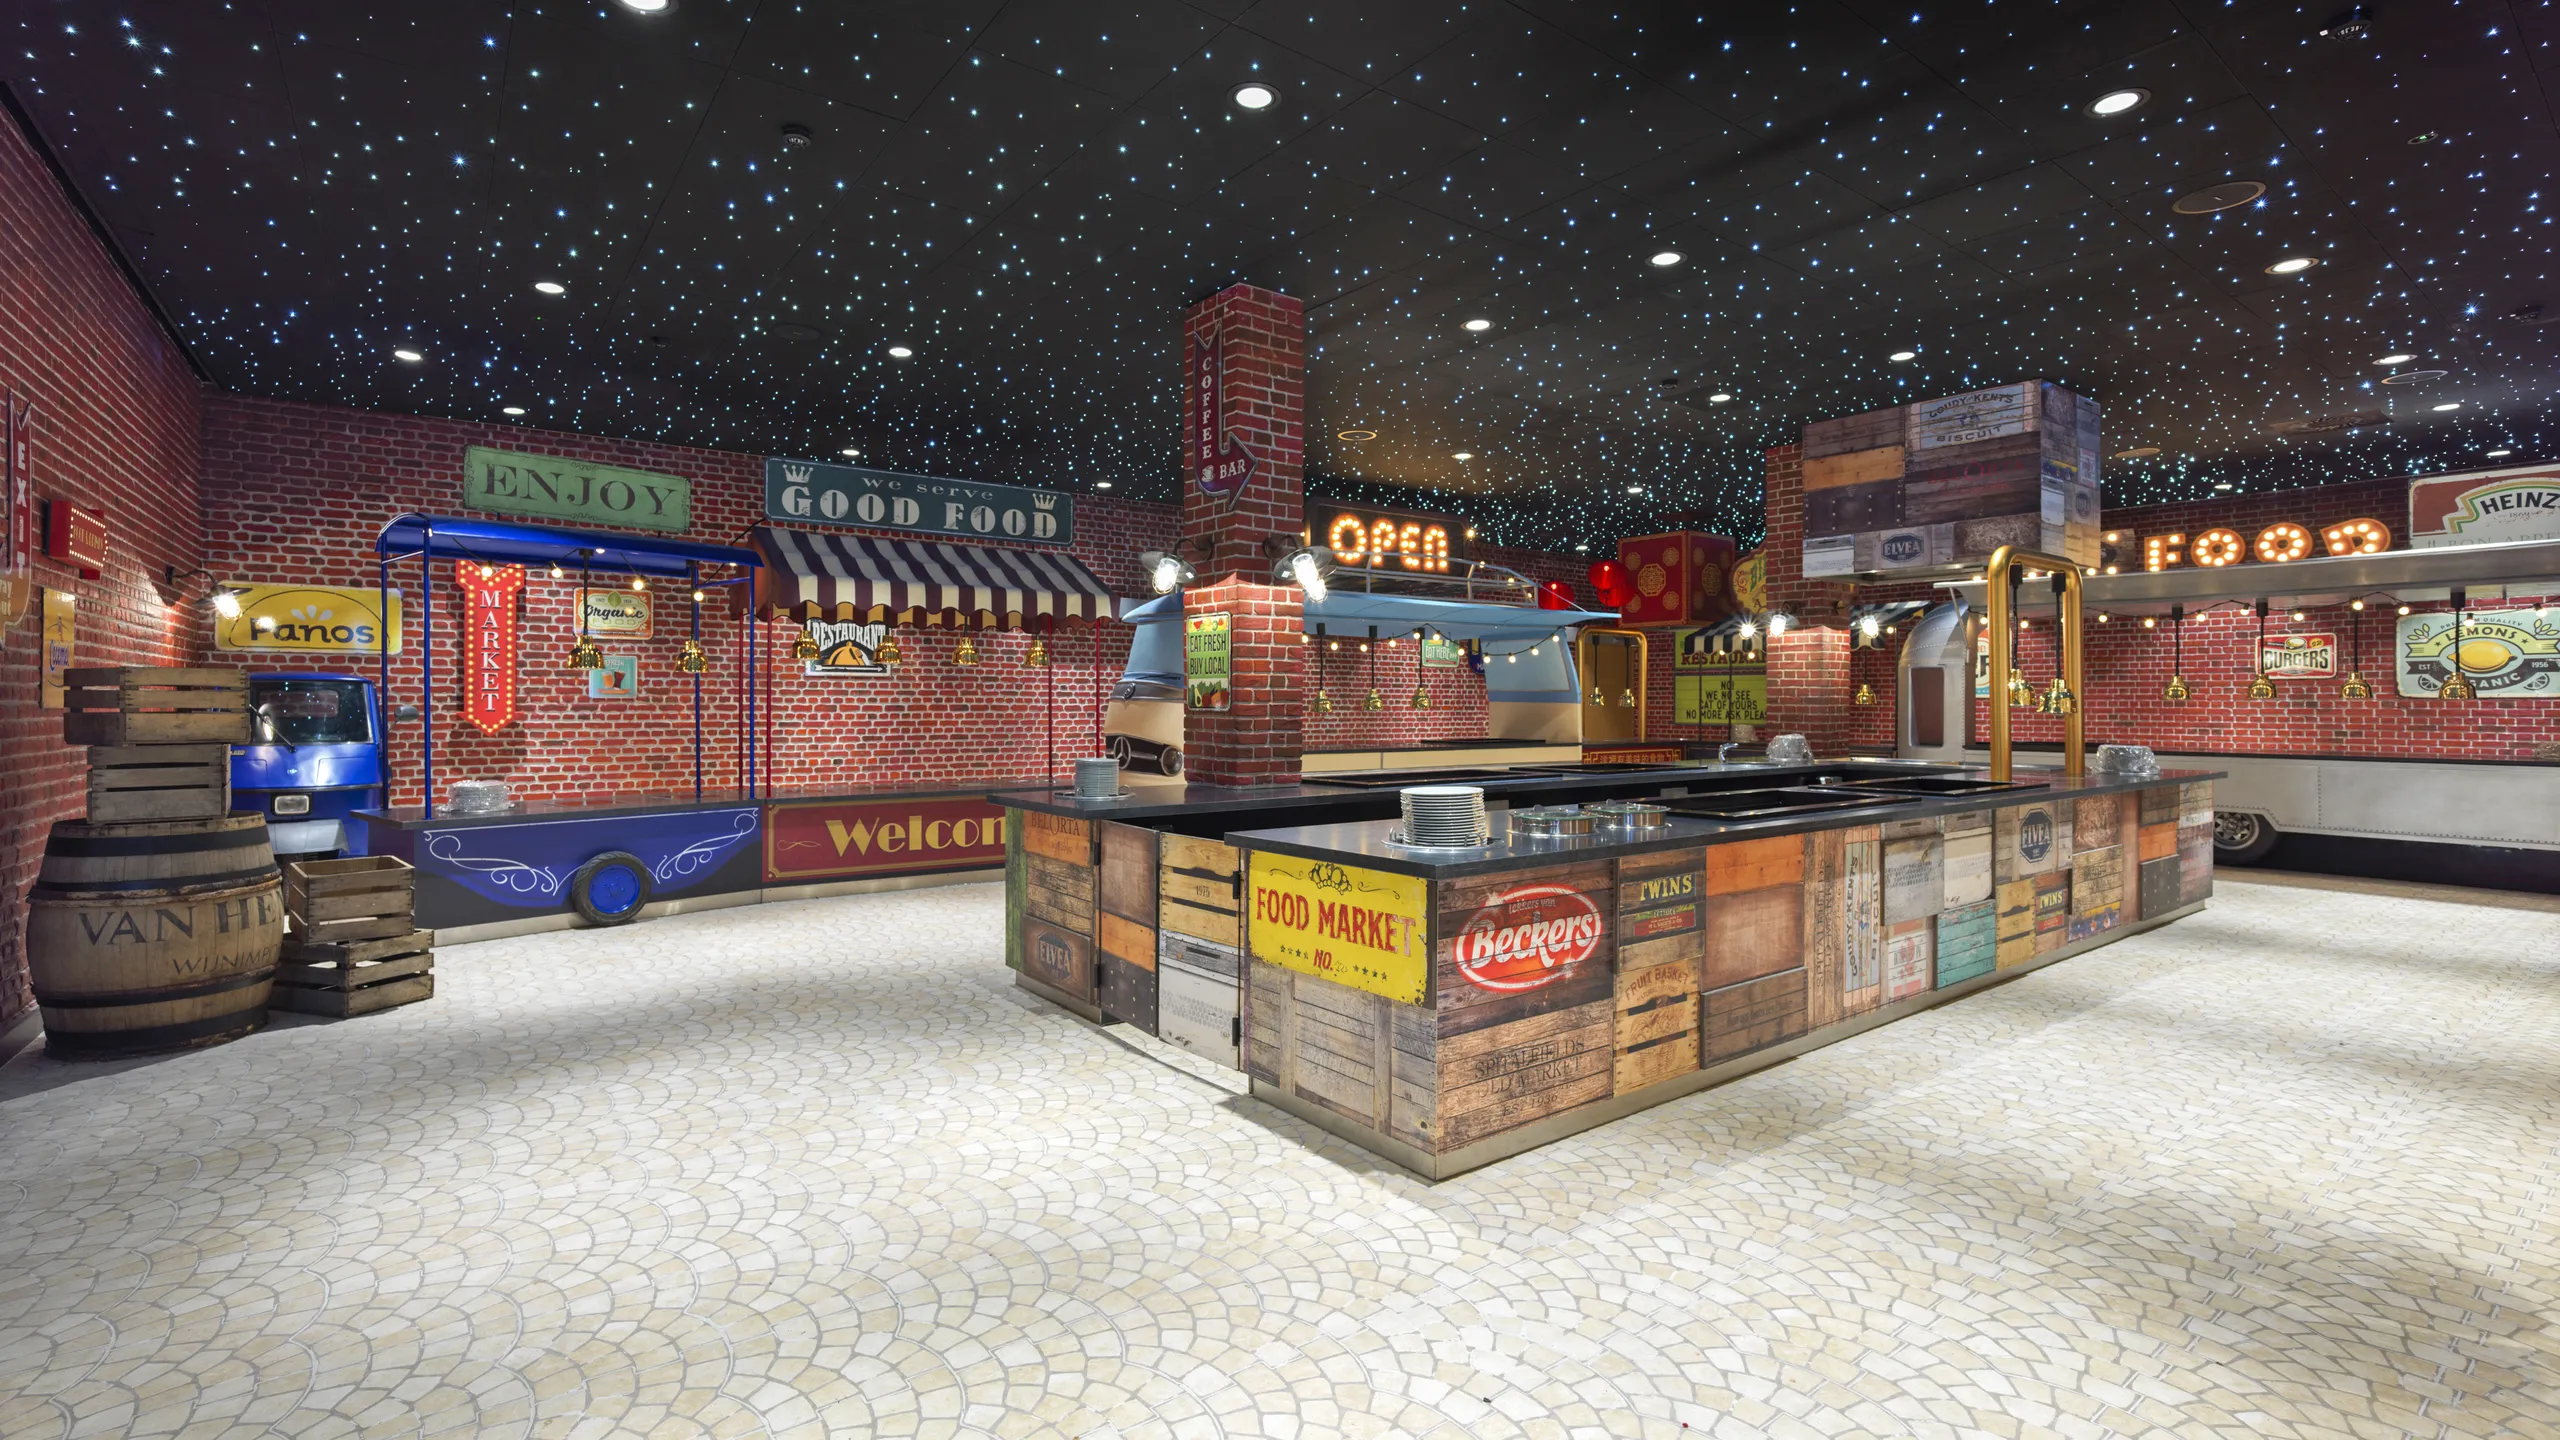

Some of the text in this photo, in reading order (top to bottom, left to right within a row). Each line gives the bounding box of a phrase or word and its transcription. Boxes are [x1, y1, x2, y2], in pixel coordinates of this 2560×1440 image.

[1201, 357, 1213, 459] COFFEE
[1936, 425, 2002, 442] BISCUIT
[1219, 459, 1247, 479] BAR
[480, 463, 677, 517] ENJOY
[861, 476, 993, 501] we serve
[16, 441, 27, 579] EXIT
[781, 486, 1058, 539] GOOD FOOD
[2480, 492, 2560, 515] HEINZ
[1884, 540, 1921, 556] ELVEA
[2144, 517, 2391, 572] FOOD
[0, 580, 12, 599] ay
[584, 604, 644, 620] Organic
[2483, 616, 2523, 627] QUALITY
[250, 615, 375, 645] Panos
[812, 621, 886, 652] RESTAURANT
[1190, 633, 1227, 652] EAT FRESH
[2445, 626, 2518, 641] LEMONS
[480, 589, 502, 713] MARKET
[2265, 648, 2329, 671] BURGERS
[1190, 656, 1227, 675] BUY LOCAL
[1700, 700, 1758, 710] CAT OF YOURS
[1705, 690, 1751, 700] WE NO SEE
[1686, 709, 1697, 719] NO
[1701, 709, 1722, 719] MORE
[1725, 709, 1742, 719] ASK
[1031, 812, 1081, 837] BELORTA
[2021, 822, 2051, 849] ELVEA
[1640, 874, 1692, 902] TWINS
[2040, 890, 2063, 909] TWINS
[79, 890, 283, 946] VAN HE
[1256, 886, 1417, 958] FOOD MARKET
[1871, 870, 1879, 961] BISCUIT
[1471, 911, 1594, 969] Beckers
[1039, 940, 1071, 974] ELVEA
[1313, 948, 1334, 971] NO.
[1625, 970, 1653, 1001] FRUIT
[1655, 967, 1690, 985] BASKET
[1475, 1038, 1585, 1079] SPITALFIELDS
